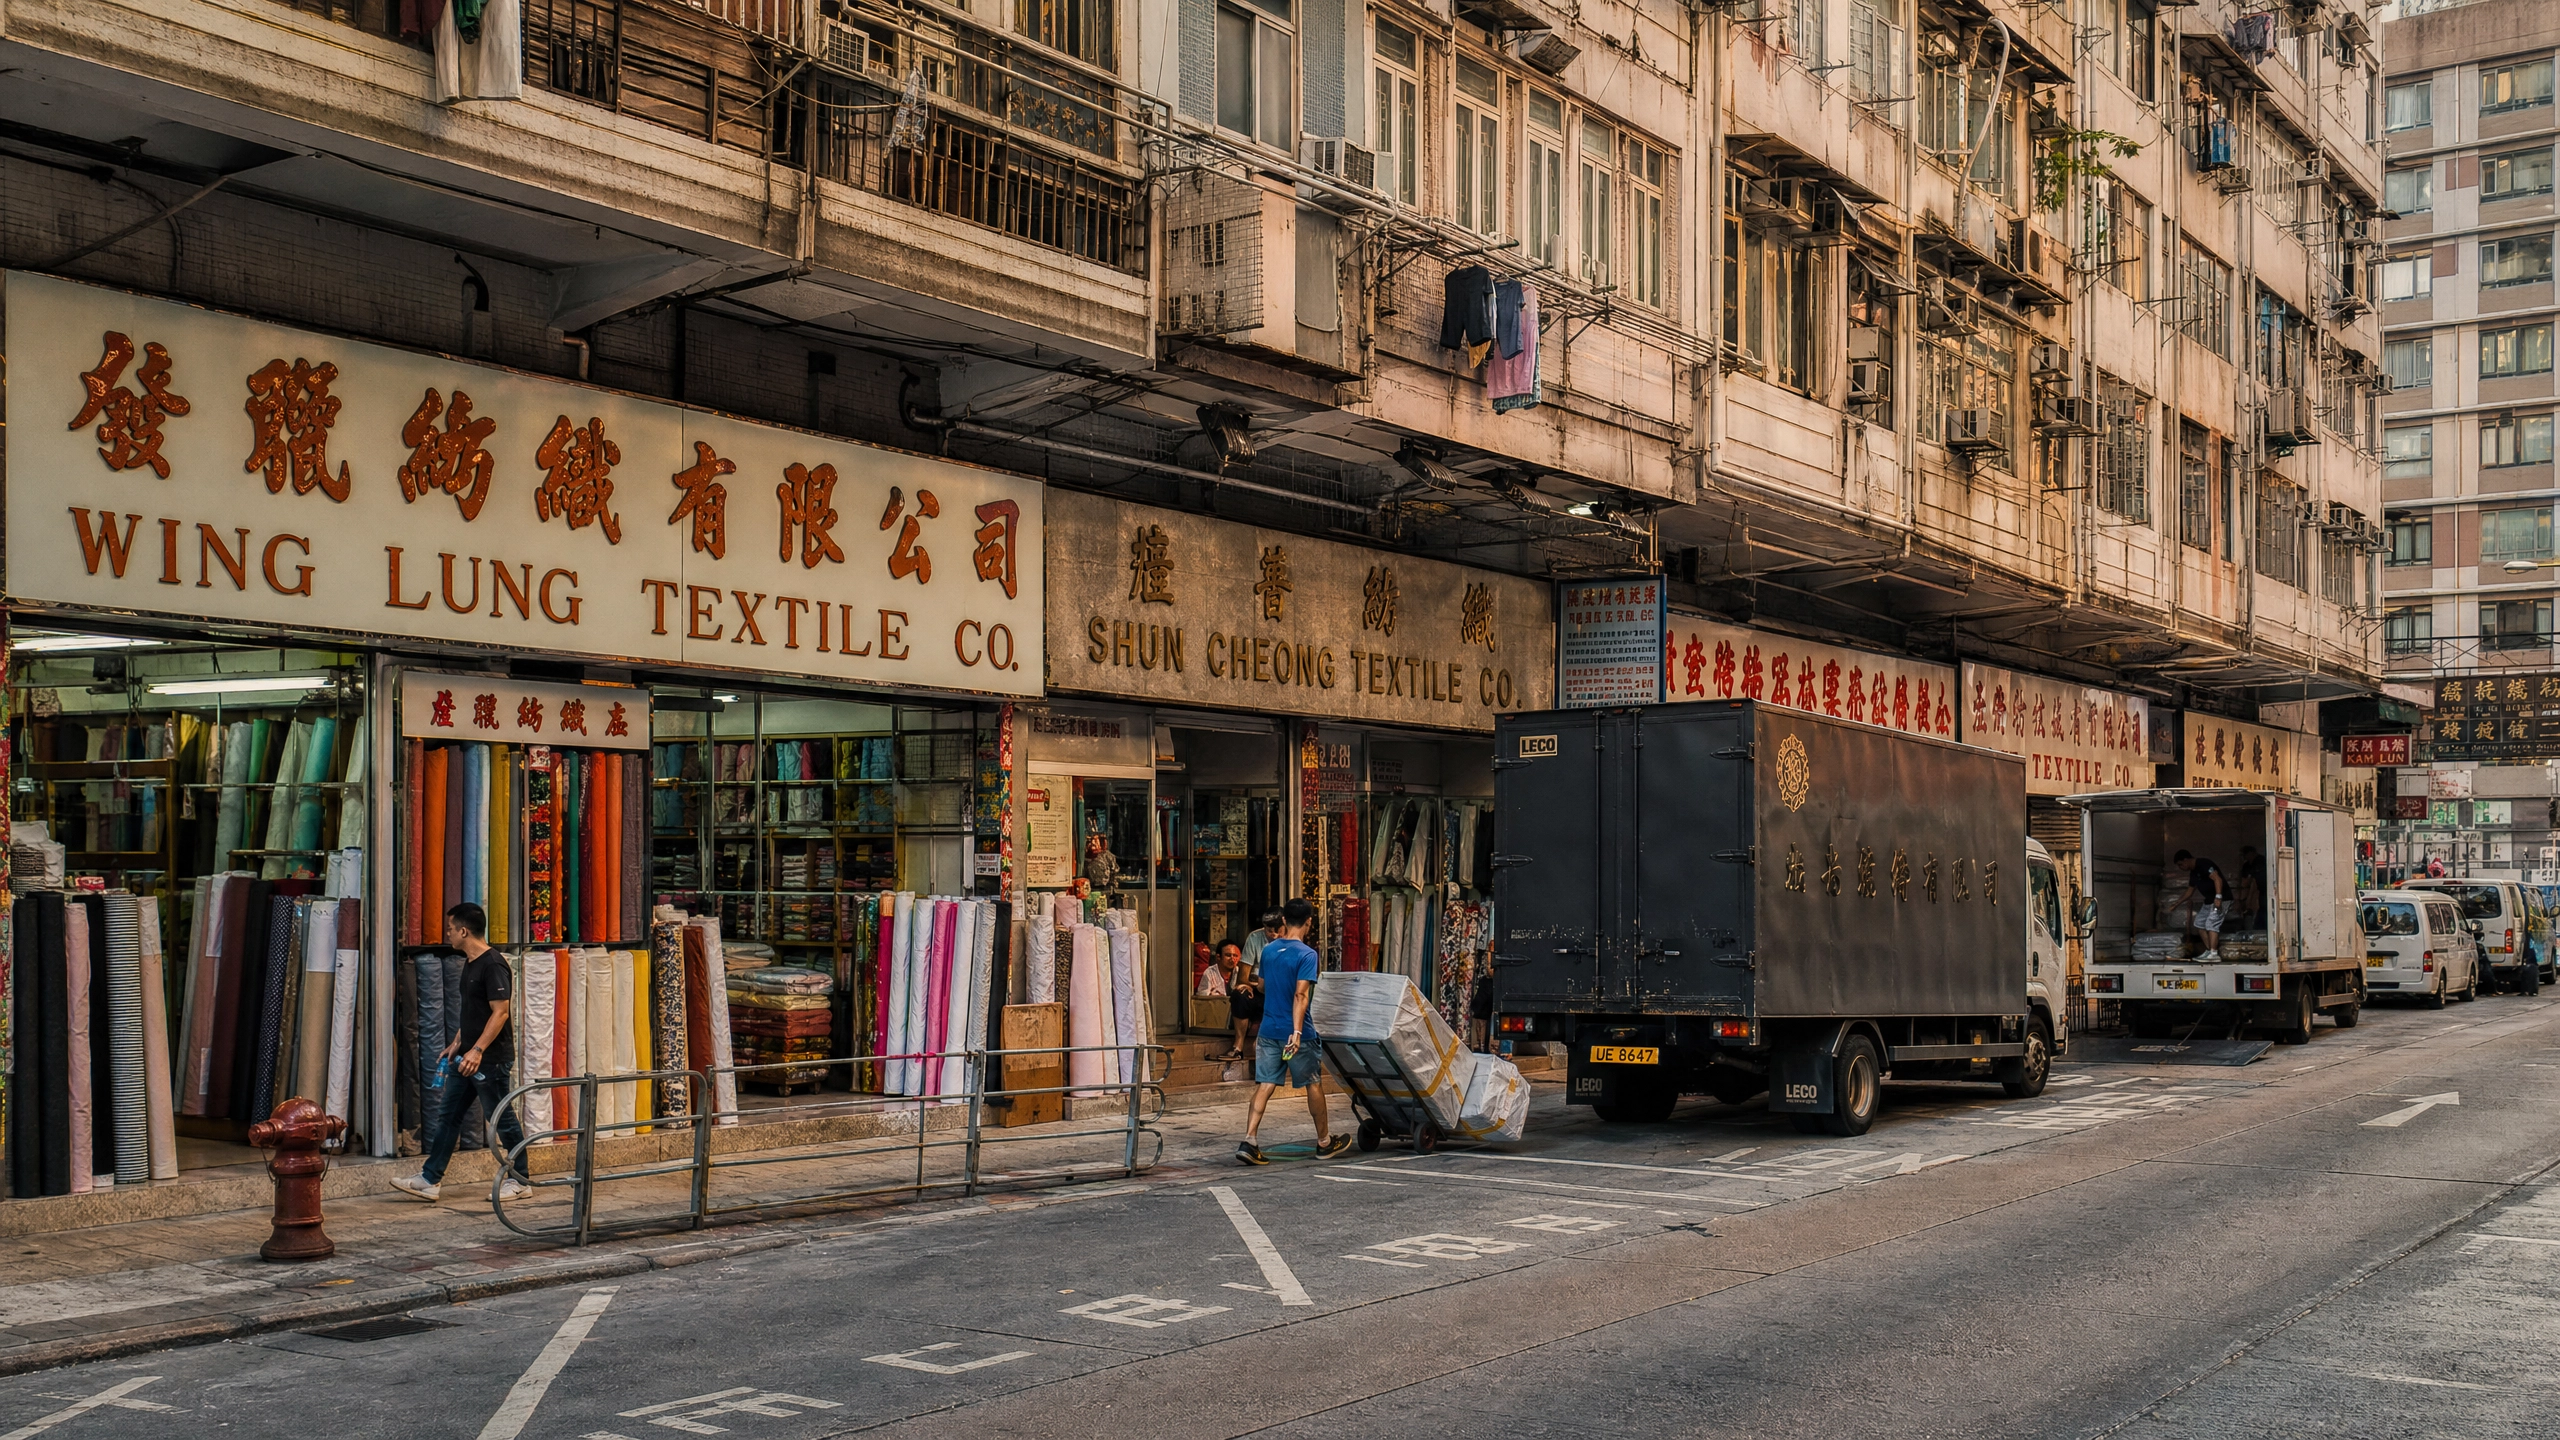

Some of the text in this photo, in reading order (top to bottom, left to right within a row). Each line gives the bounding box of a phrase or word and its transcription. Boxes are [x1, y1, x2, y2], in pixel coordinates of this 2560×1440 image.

[69, 506, 1019, 671] WING LUNG TEXTILE CO.
[1088, 615, 1184, 673] SHUN
[1207, 632, 1335, 689] CHEONG
[1350, 650, 1463, 703] TEXTILE
[1479, 667, 1522, 709] CO.
[1521, 737, 1557, 755] LECO
[2347, 753, 2405, 764] KAM LUN
[2032, 753, 2134, 788] TEXTILE CO.
[1596, 1048, 1654, 1063] UE 8647
[1575, 1078, 1603, 1092] LECO
[1785, 1084, 1817, 1099] LECO
